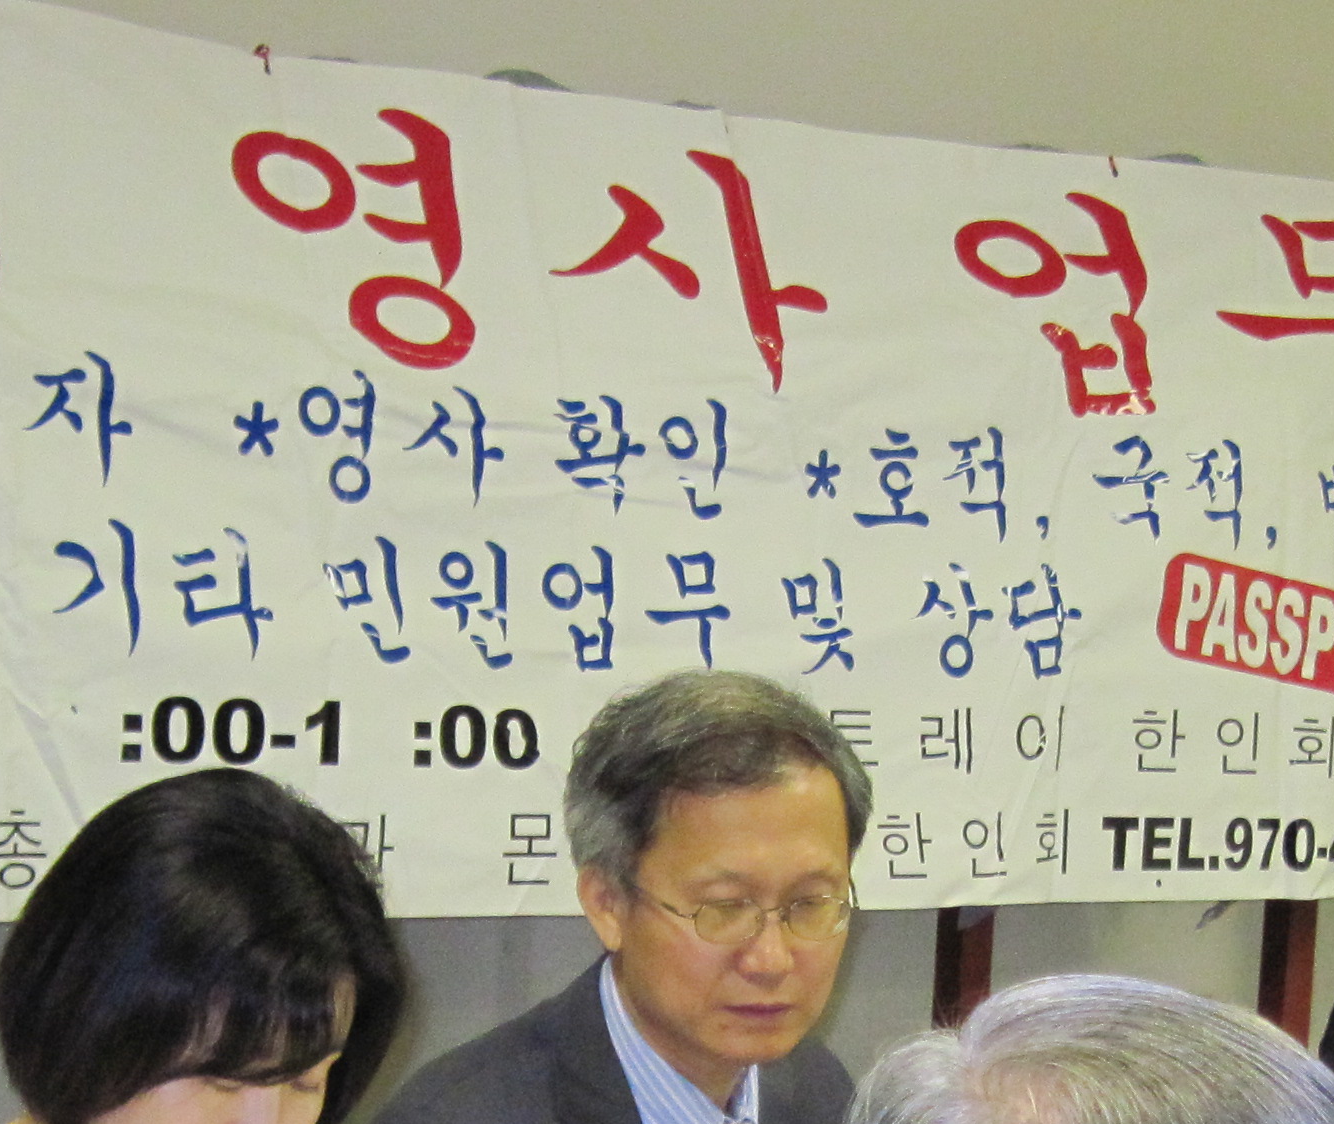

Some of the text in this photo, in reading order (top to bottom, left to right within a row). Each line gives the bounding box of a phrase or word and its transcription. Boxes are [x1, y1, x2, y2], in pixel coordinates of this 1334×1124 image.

[231, 109, 828, 392] 영사
[555, 395, 727, 519] 확인
[781, 558, 854, 675] 및
[912, 562, 1082, 679] 상담
